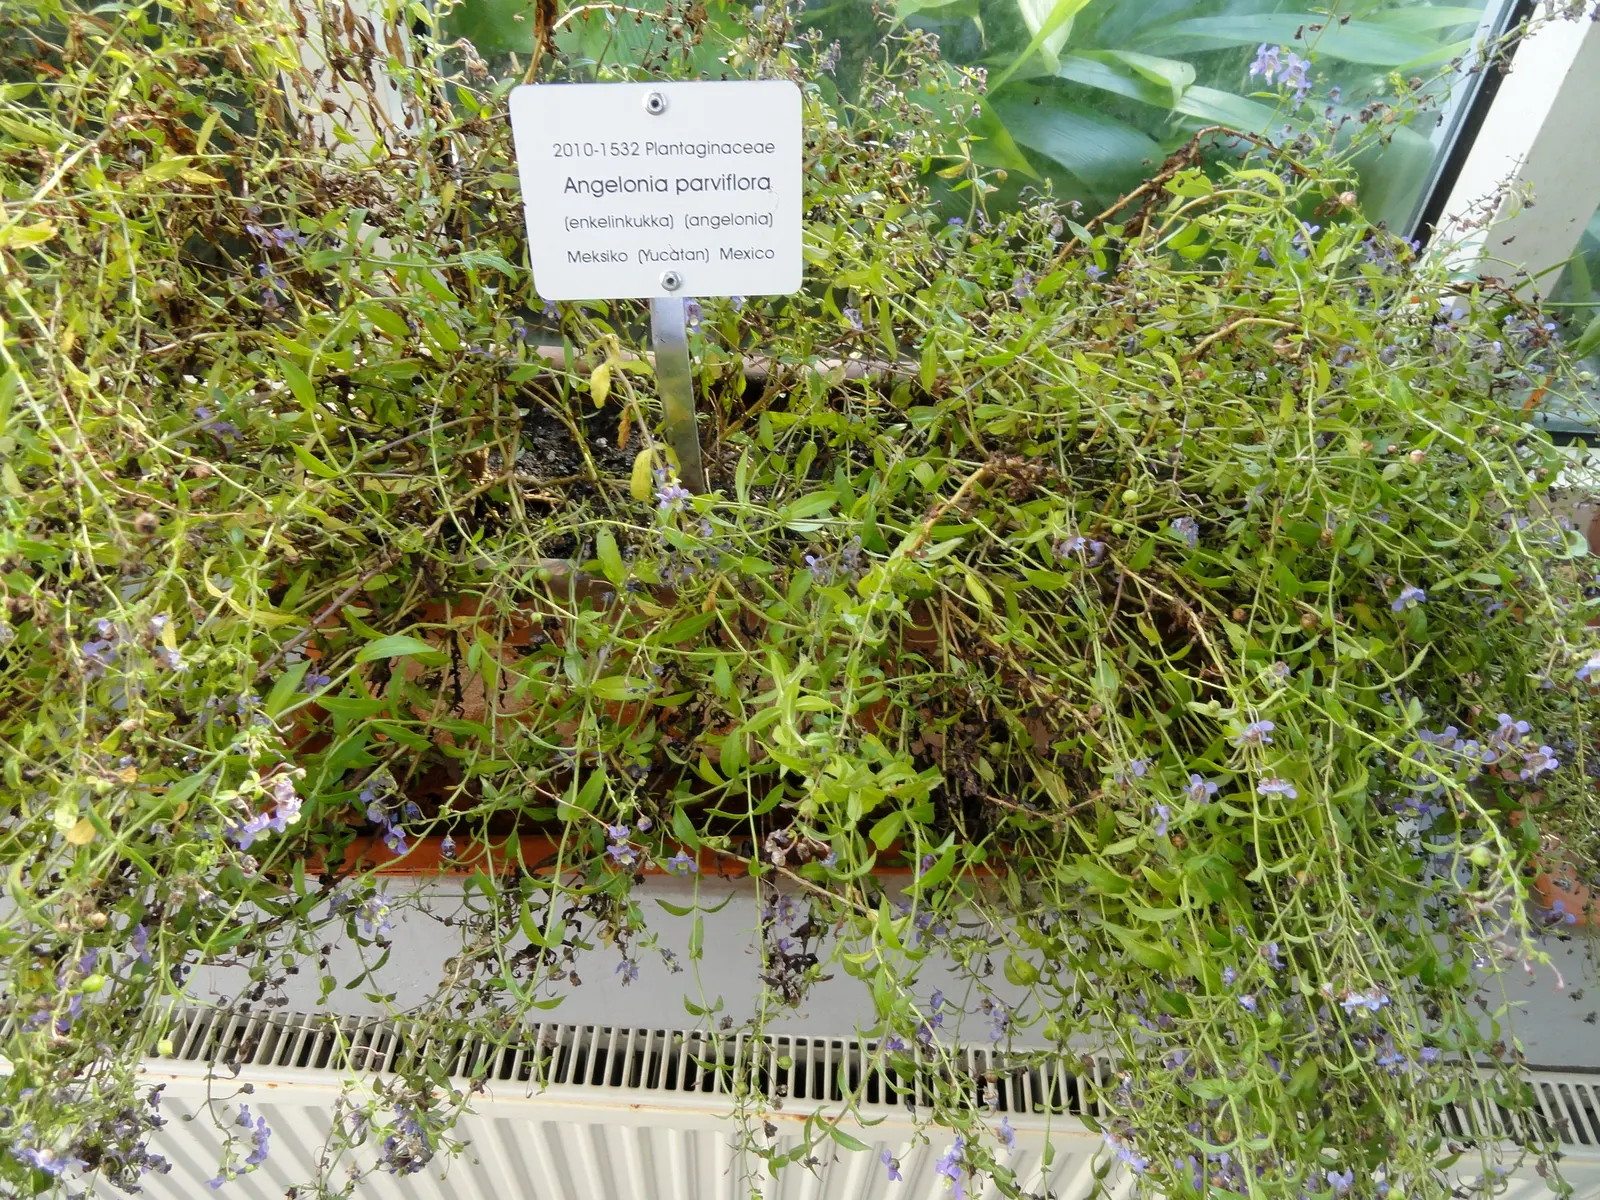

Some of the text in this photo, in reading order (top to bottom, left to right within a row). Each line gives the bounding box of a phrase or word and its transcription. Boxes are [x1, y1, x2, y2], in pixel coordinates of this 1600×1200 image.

[553, 140, 776, 158] 2010-1532 Plantaginaceae
[563, 173, 771, 198] Angelonia parviflora
[564, 211, 773, 231] (enkelinkukka) (angelonia)
[567, 250, 628, 264] Meksiko
[719, 246, 775, 261] Mexico
